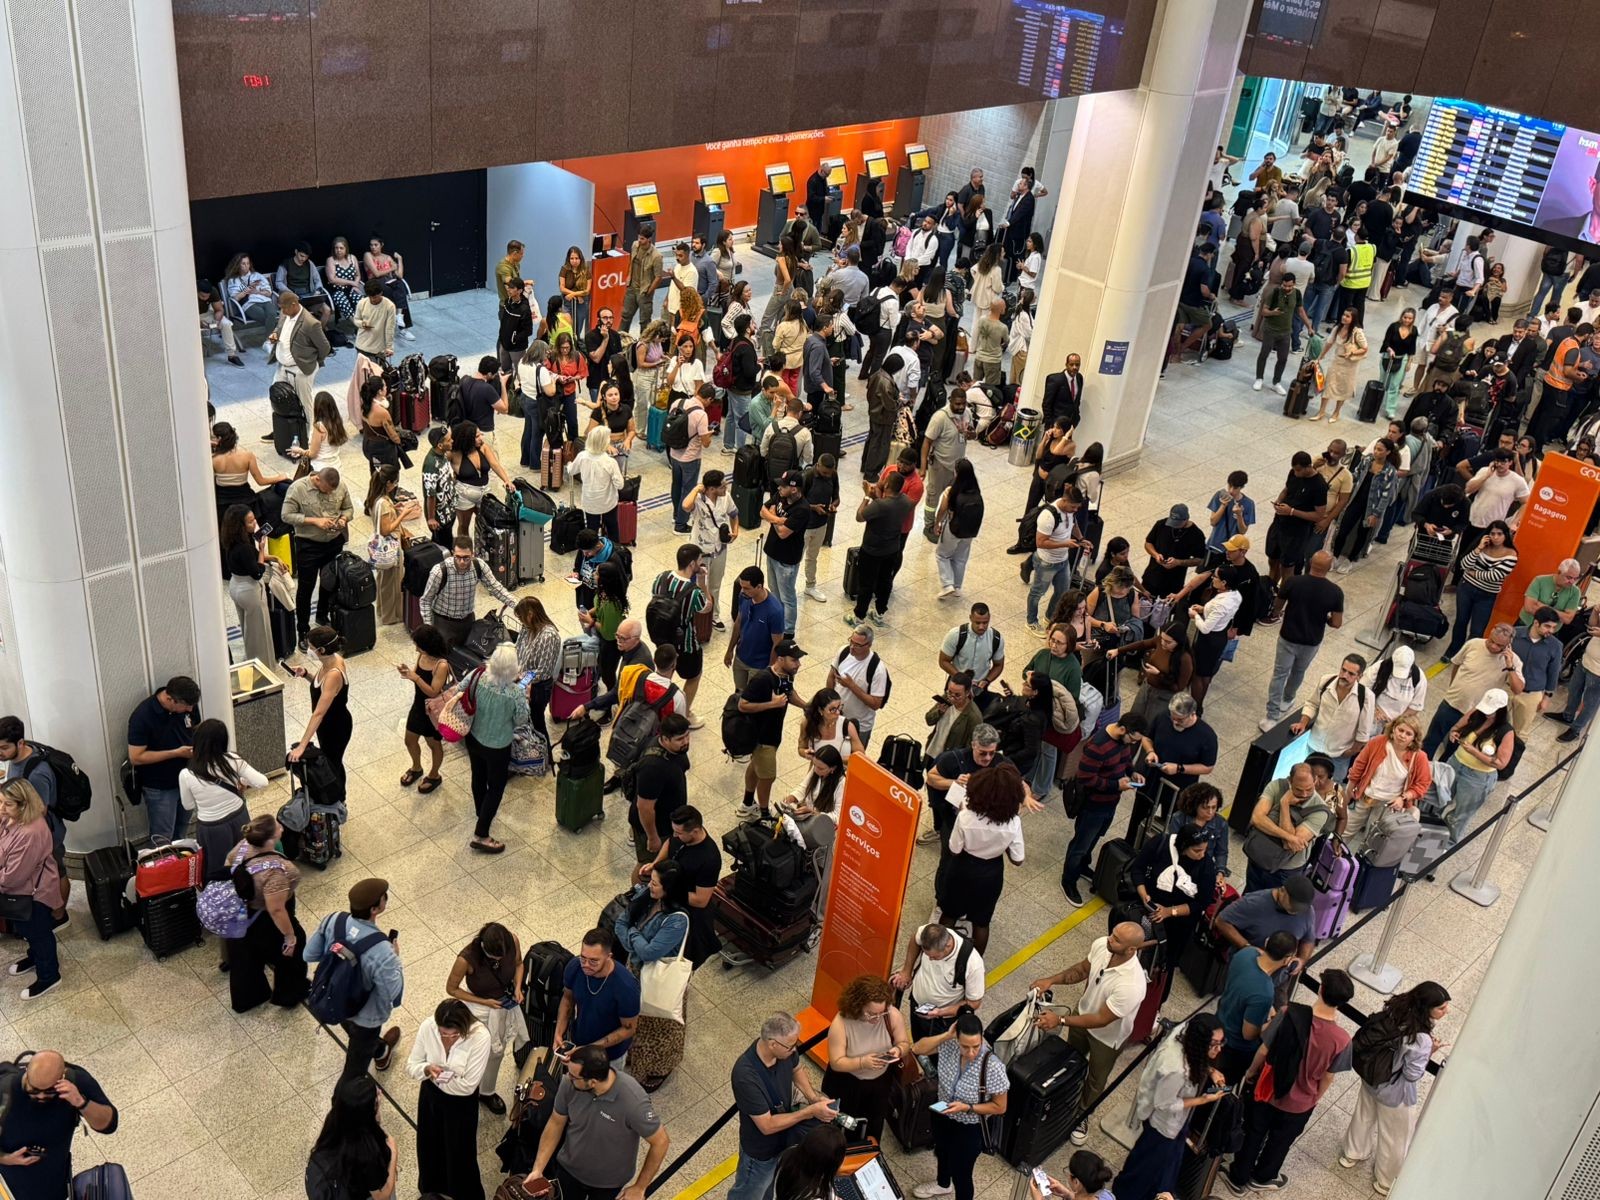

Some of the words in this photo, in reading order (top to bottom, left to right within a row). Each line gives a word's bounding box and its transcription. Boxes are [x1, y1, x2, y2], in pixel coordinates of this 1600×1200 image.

[722, 139, 741, 151] ganha
[742, 138, 762, 147] tempo
[768, 134, 784, 143] evita
[598, 271, 626, 290] GOL
[1533, 503, 1567, 521] Bagagem
[889, 785, 914, 811] GOL
[846, 828, 880, 859] Serviços
